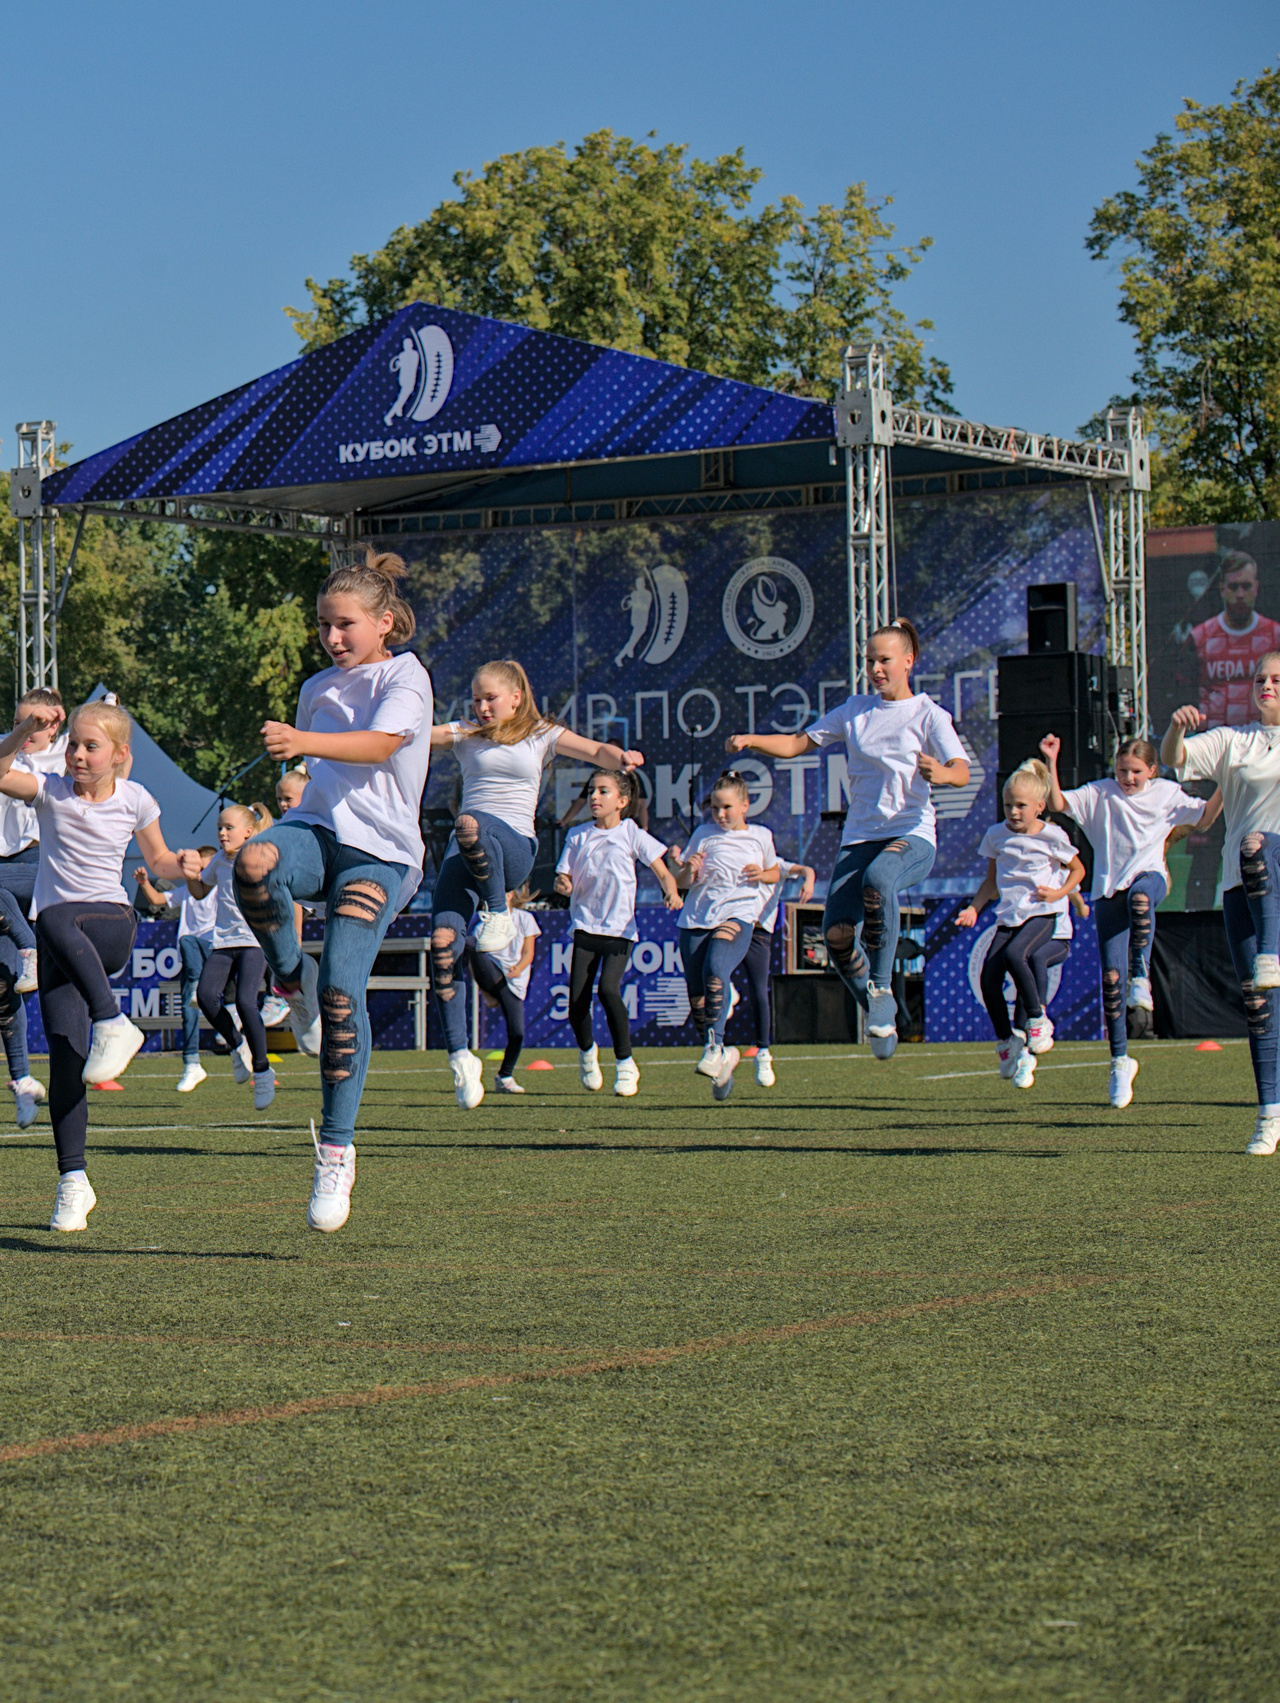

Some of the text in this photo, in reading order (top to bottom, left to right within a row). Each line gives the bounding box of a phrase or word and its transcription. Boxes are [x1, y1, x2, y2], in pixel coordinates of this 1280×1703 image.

[338, 430, 472, 464] КУБОК ЭТМ
[1206, 659, 1245, 679] VEDA
[635, 687, 721, 740] ПО
[551, 941, 685, 975] КОК
